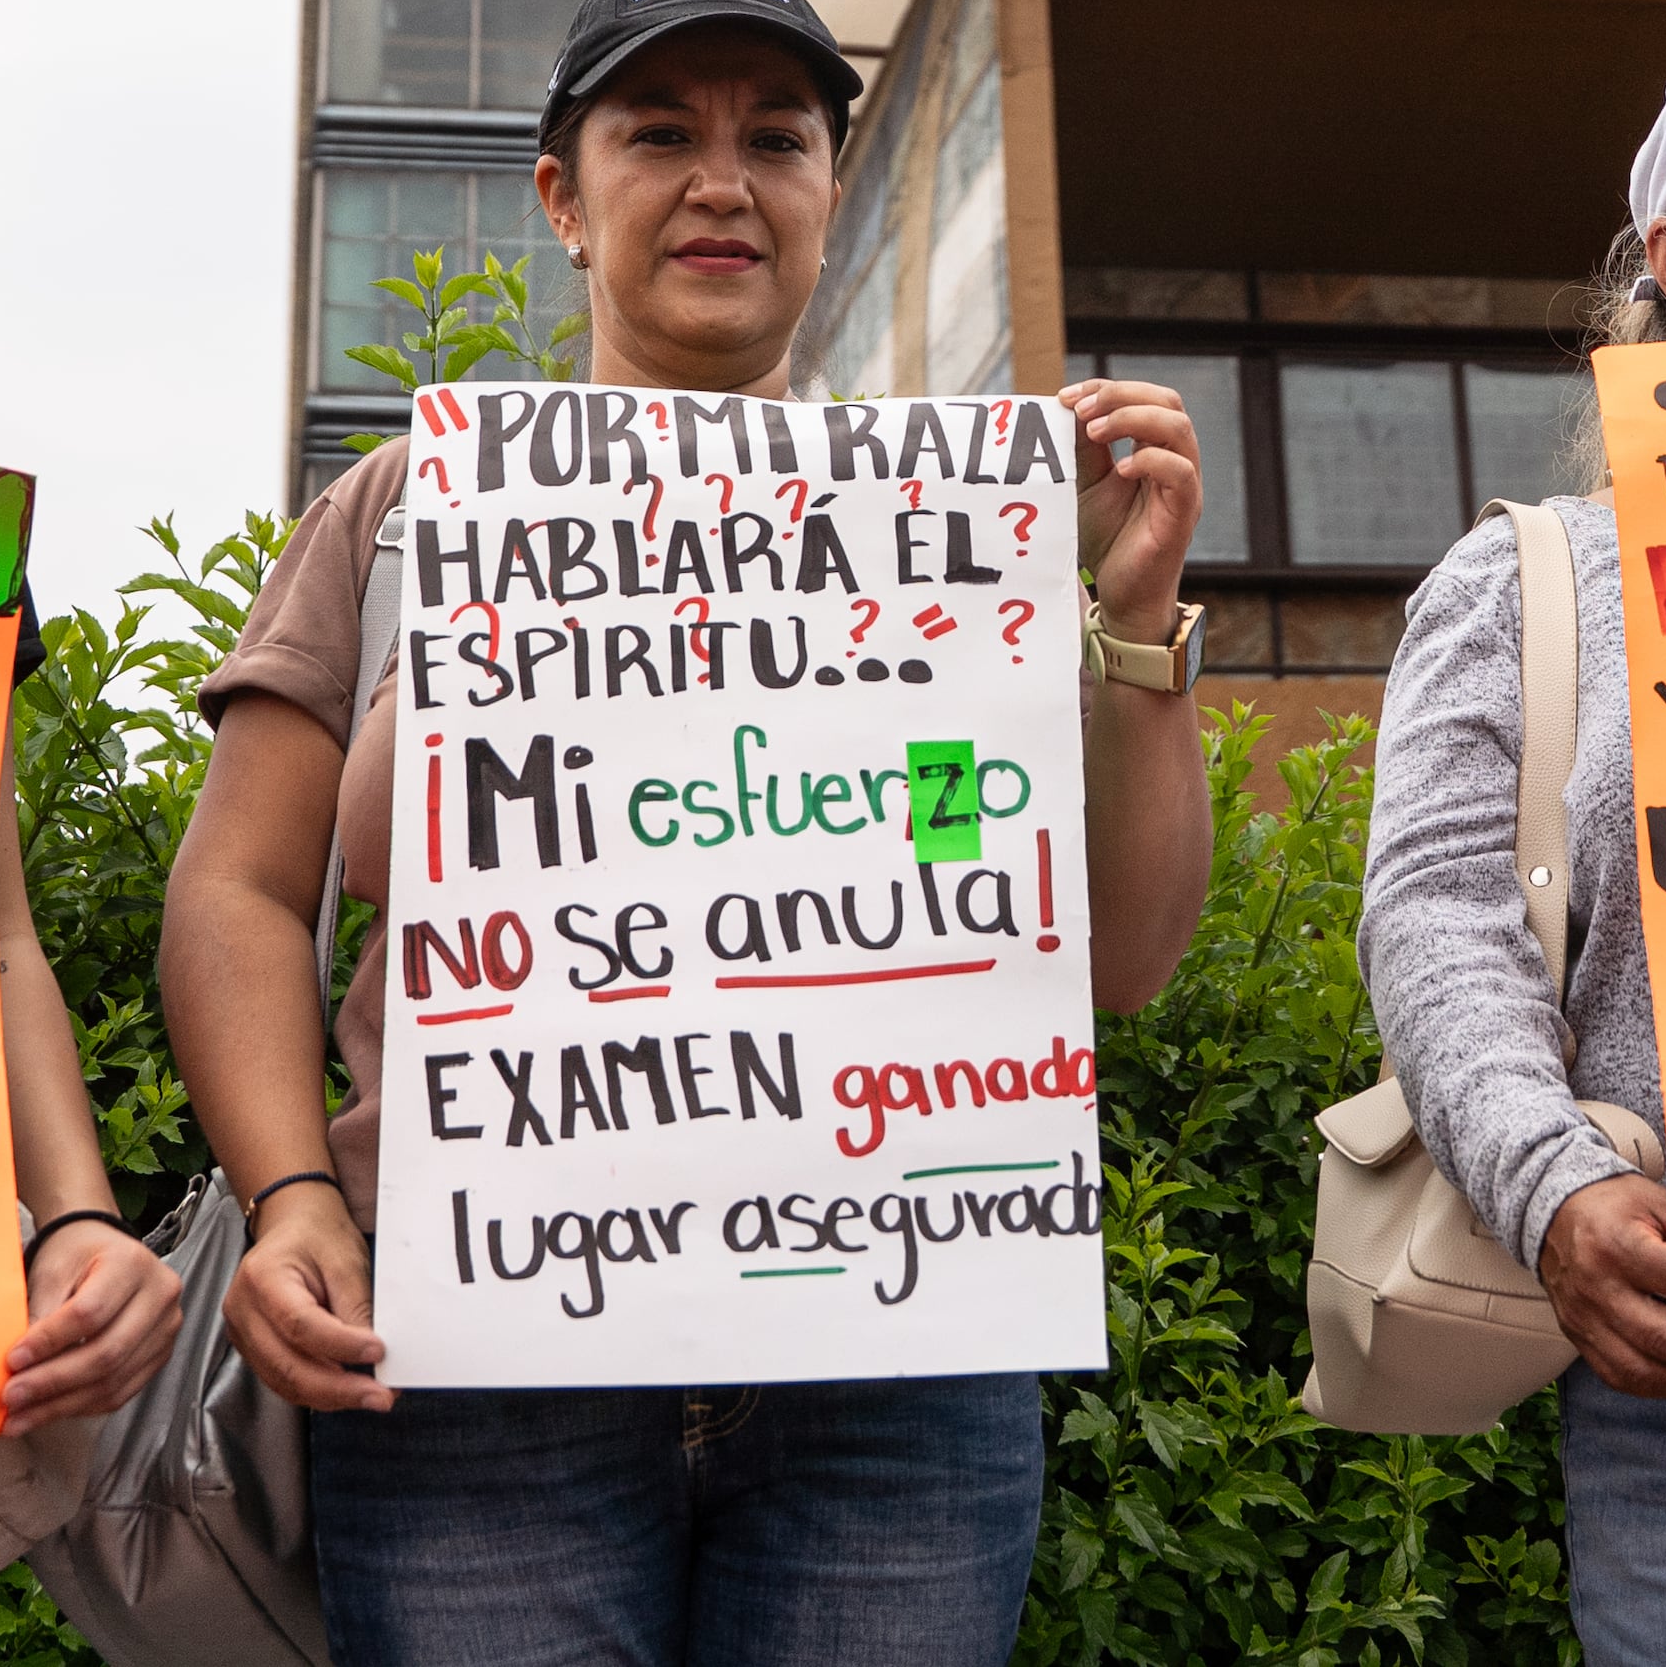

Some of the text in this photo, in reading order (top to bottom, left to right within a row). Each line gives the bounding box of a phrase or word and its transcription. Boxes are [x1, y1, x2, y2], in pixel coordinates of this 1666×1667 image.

[673, 396, 802, 483] MI
[823, 401, 1066, 485] RAZA
[416, 491, 860, 609] HABLARÁ
[402, 827, 1062, 1000] NO se anula!
[424, 1029, 1096, 1158] EXAMEN ganado
[451, 1150, 1102, 1319] lugar asegurado
